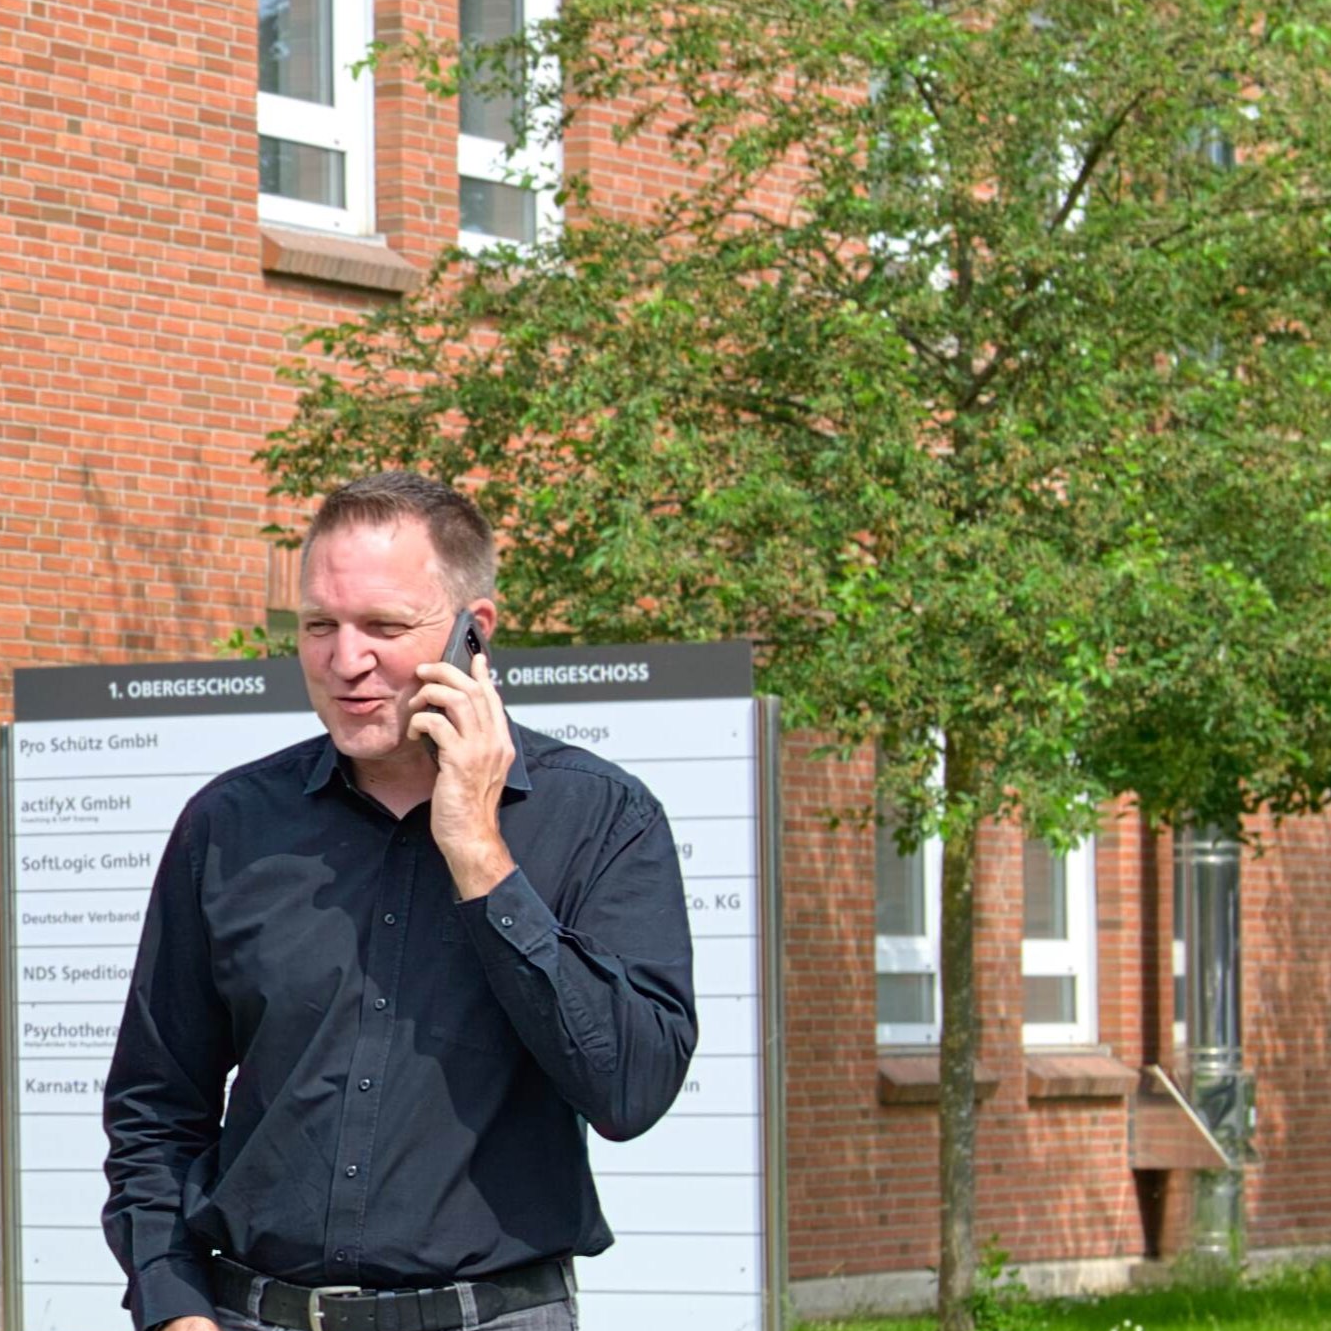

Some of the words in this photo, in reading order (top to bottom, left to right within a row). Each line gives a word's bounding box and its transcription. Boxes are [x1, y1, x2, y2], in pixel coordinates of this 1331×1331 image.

[508, 663, 649, 685] OBERGESCHOSS
[108, 683, 123, 699] 1.
[128, 675, 265, 698] OBERGESCHOSS
[20, 739, 45, 753] Pro
[51, 736, 102, 752] Schütz
[109, 733, 158, 749] GmbH
[21, 797, 75, 814] actifyX
[81, 796, 131, 811] GmbH
[22, 854, 95, 874] SoftLogic
[101, 853, 151, 869] GmbH
[715, 893, 741, 910] KG
[22, 913, 84, 925] Deutscher
[88, 911, 140, 923] Verband
[24, 966, 57, 981] NDS
[26, 1078, 88, 1094] Karnatz
